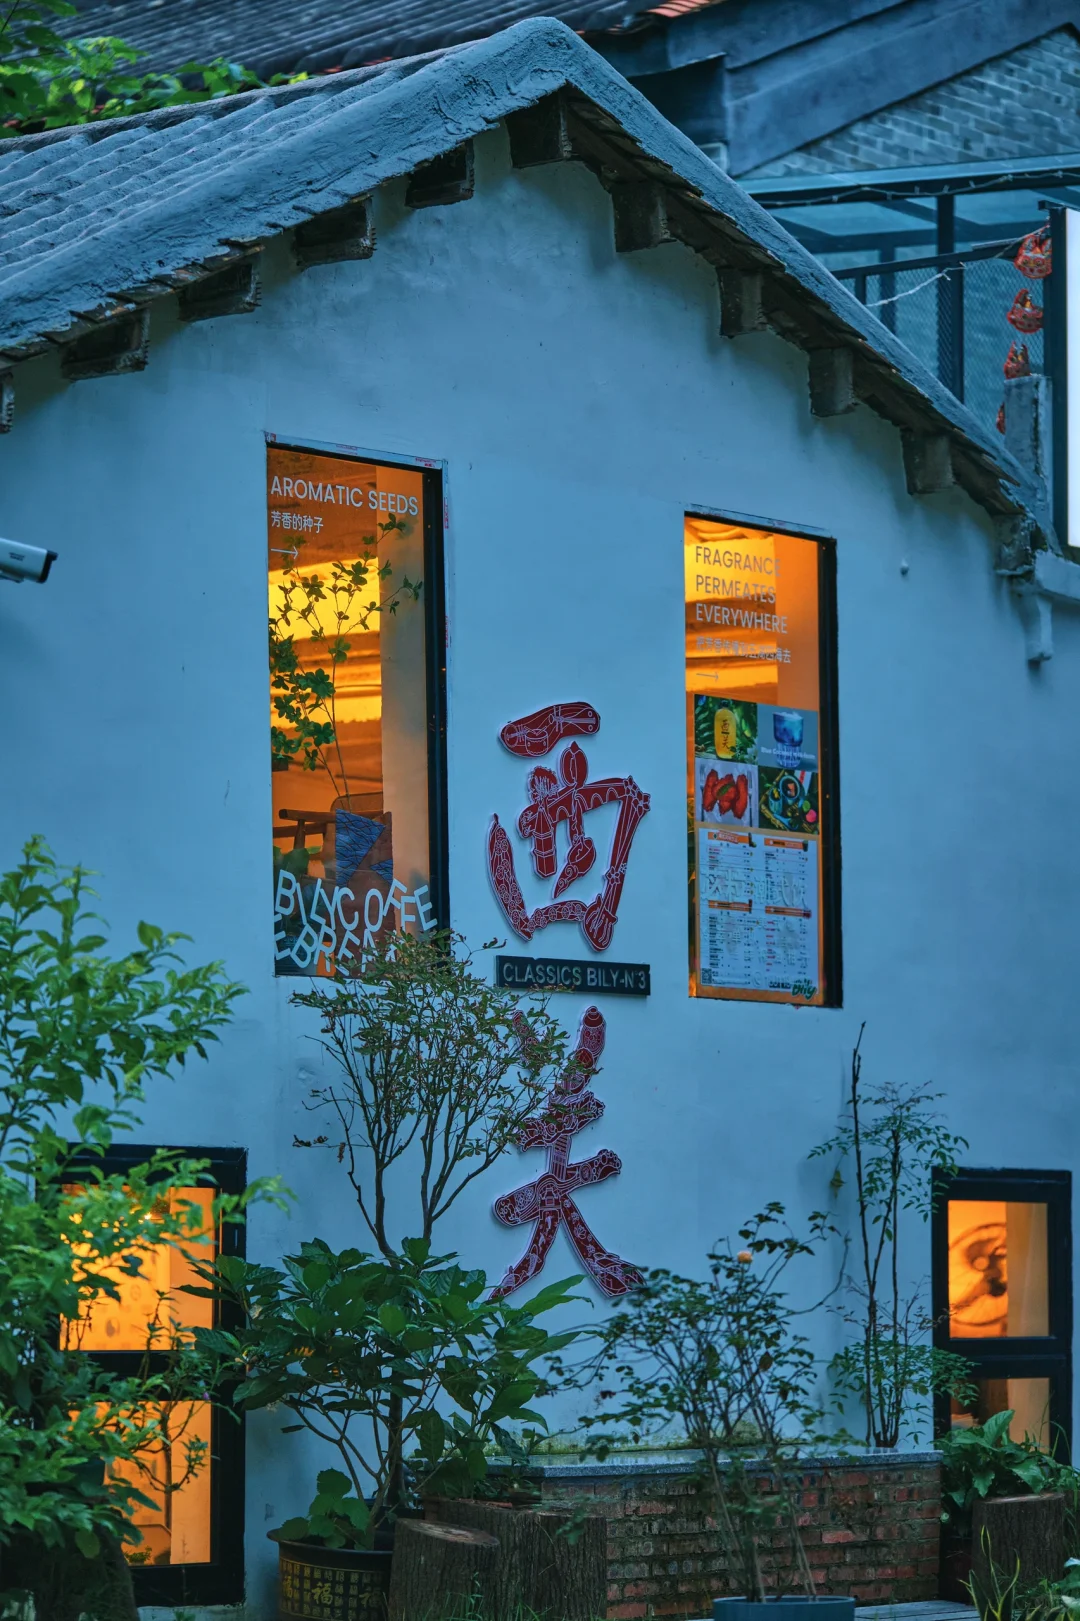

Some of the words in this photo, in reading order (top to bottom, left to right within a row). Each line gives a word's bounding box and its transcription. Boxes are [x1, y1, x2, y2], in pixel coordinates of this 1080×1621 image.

[270, 475, 363, 508] AROMATIC
[368, 490, 419, 516] SEEDS
[271, 510, 324, 533] 芳香的种子
[695, 545, 782, 577] FRAGRANCE
[696, 574, 776, 604] PERMEATES
[696, 603, 788, 634] EVERYWHERE
[503, 962, 582, 986] CLASSICS
[311, 1581, 333, 1605] 福
